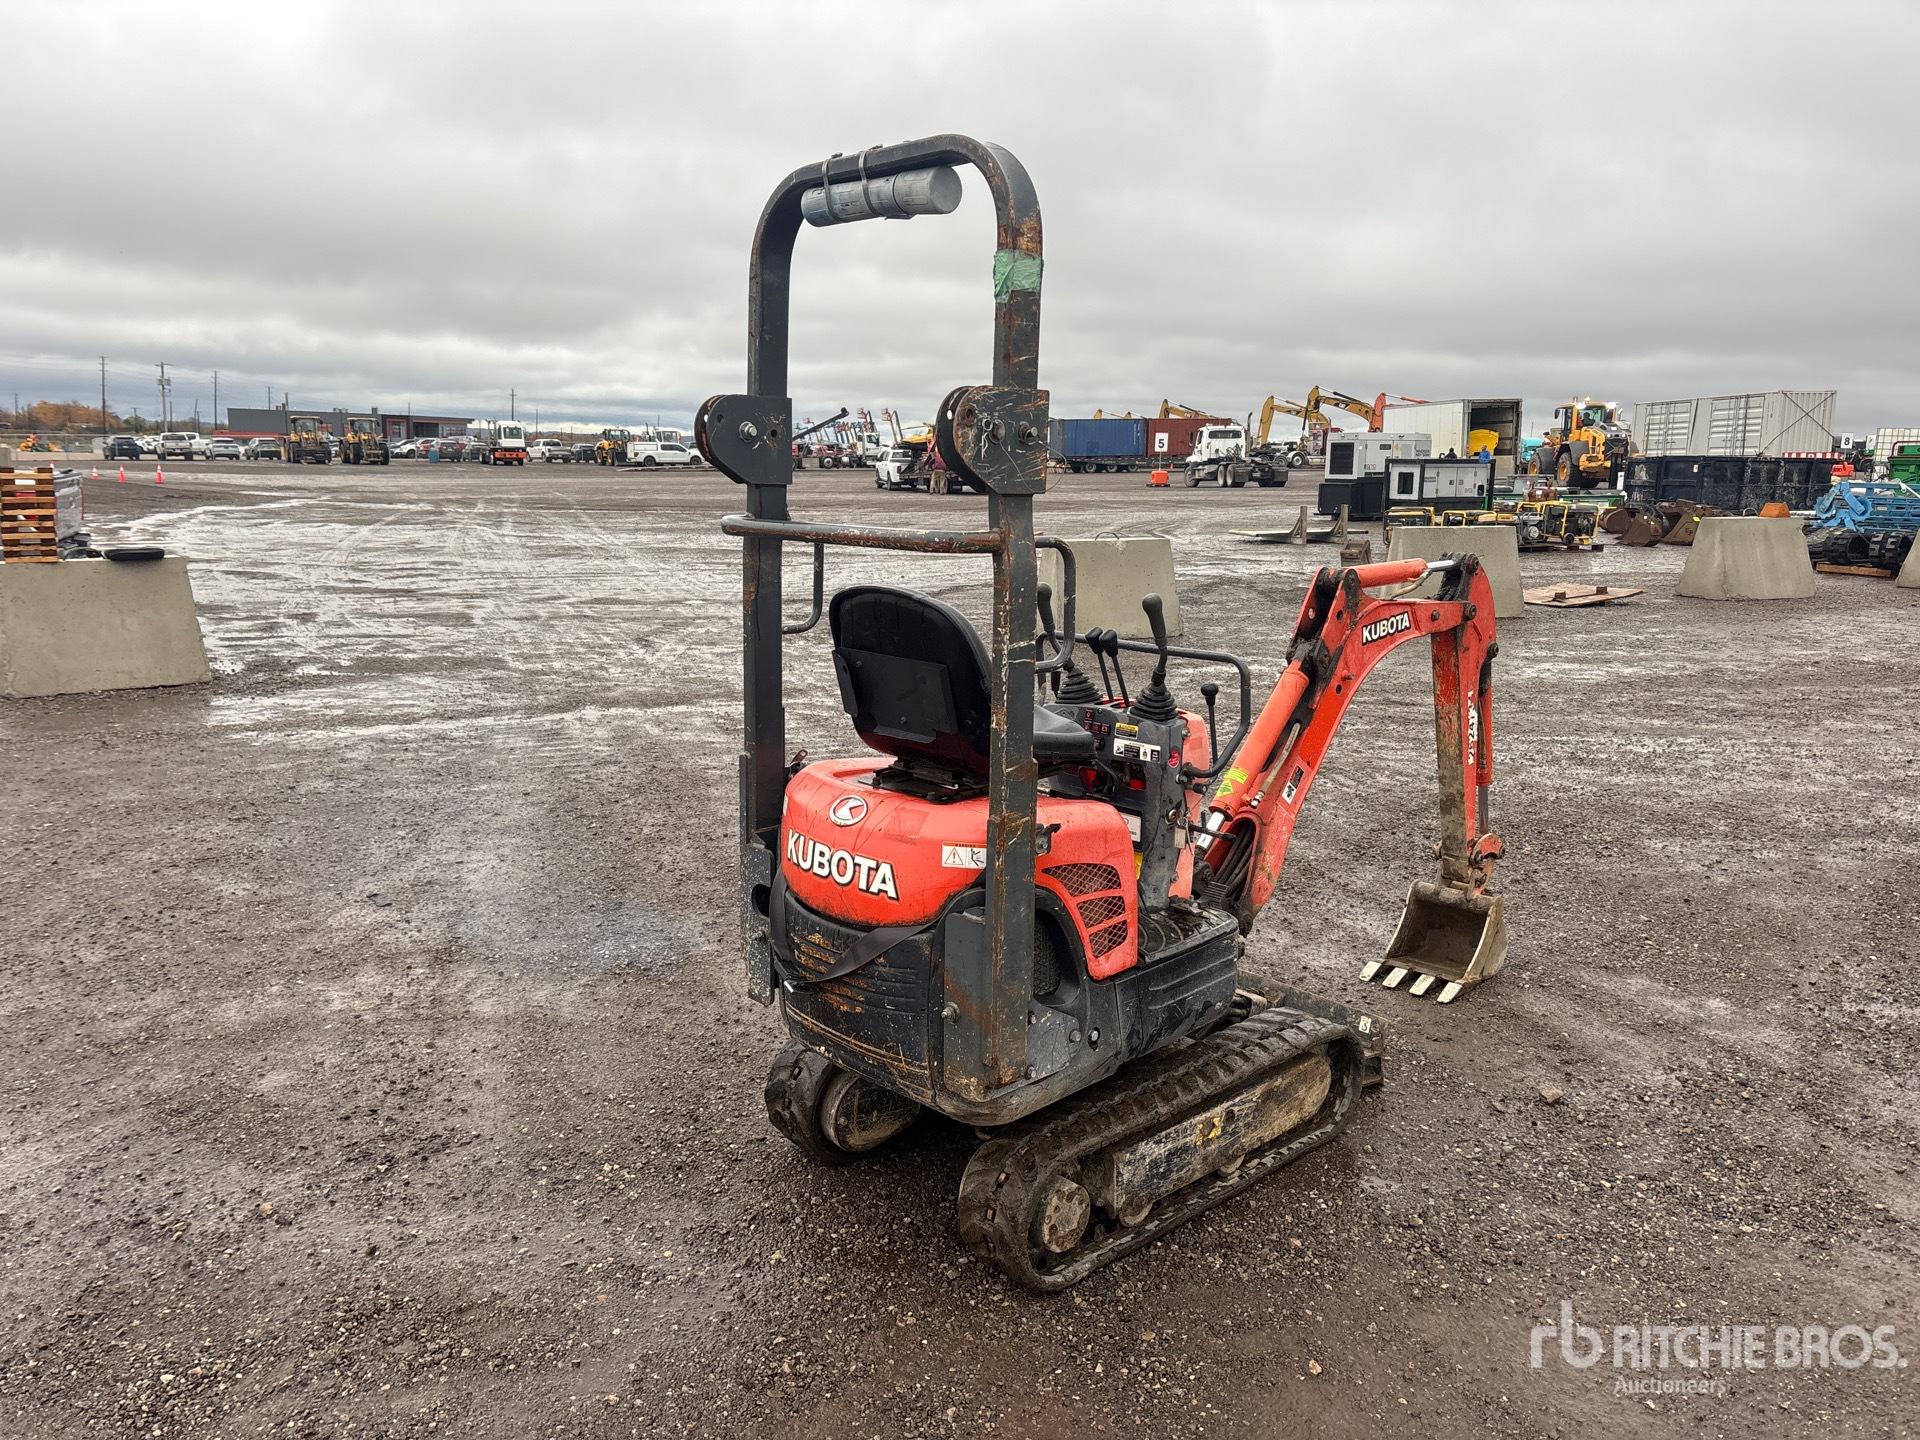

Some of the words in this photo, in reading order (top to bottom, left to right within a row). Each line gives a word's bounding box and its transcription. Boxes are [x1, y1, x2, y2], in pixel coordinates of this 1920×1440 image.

[1158, 438, 1165, 449] 5
[1844, 437, 1851, 446] 8
[1362, 611, 1411, 645] KUBOTA
[787, 828, 899, 900] KUBOTA
